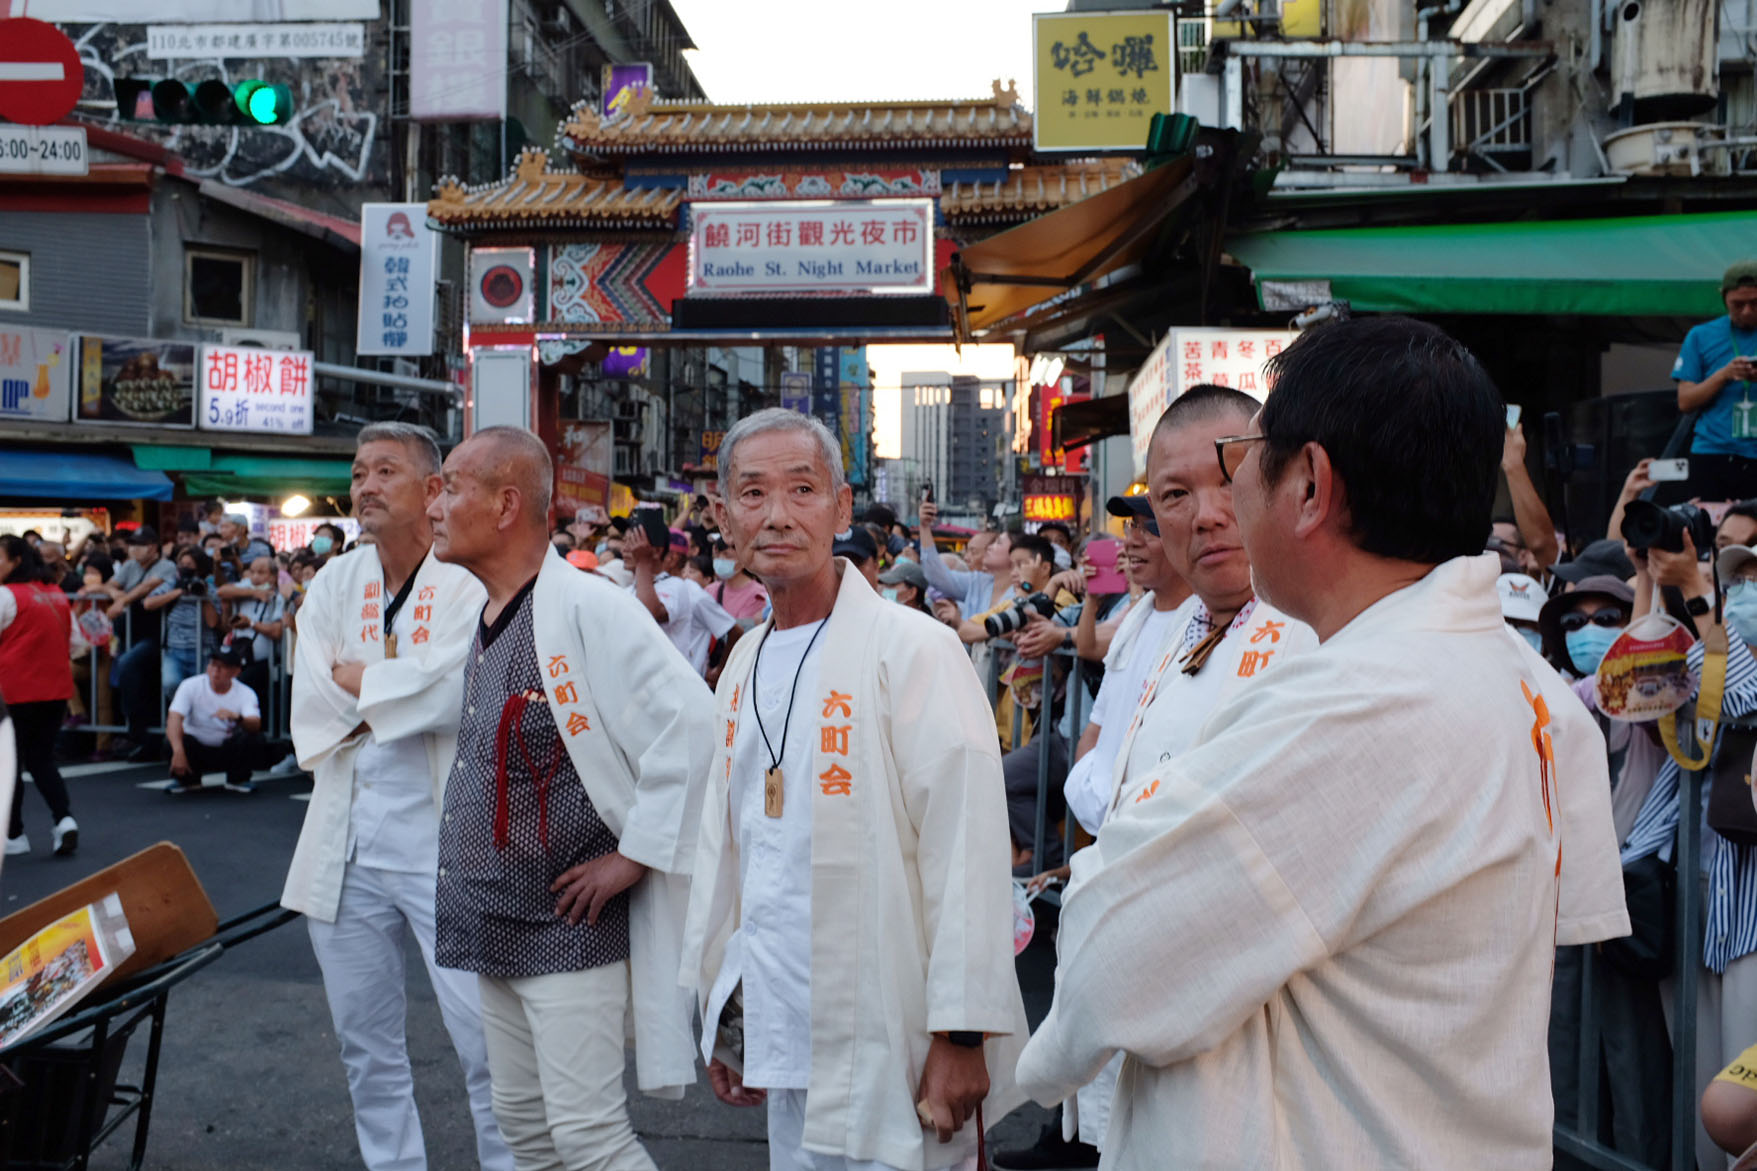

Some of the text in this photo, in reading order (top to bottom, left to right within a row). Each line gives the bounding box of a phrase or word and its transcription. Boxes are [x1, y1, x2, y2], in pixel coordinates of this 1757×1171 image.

[704, 219, 918, 248] 饒河街觀光夜市
[703, 259, 919, 279] Raohe St. Night Market
[207, 349, 308, 397] 胡椒餅
[1184, 341, 1203, 388] 苦茶
[209, 397, 250, 427] 5.9折
[269, 523, 319, 553] 胡椒
[547, 654, 591, 737] 六町会
[819, 689, 853, 797] 六町会
